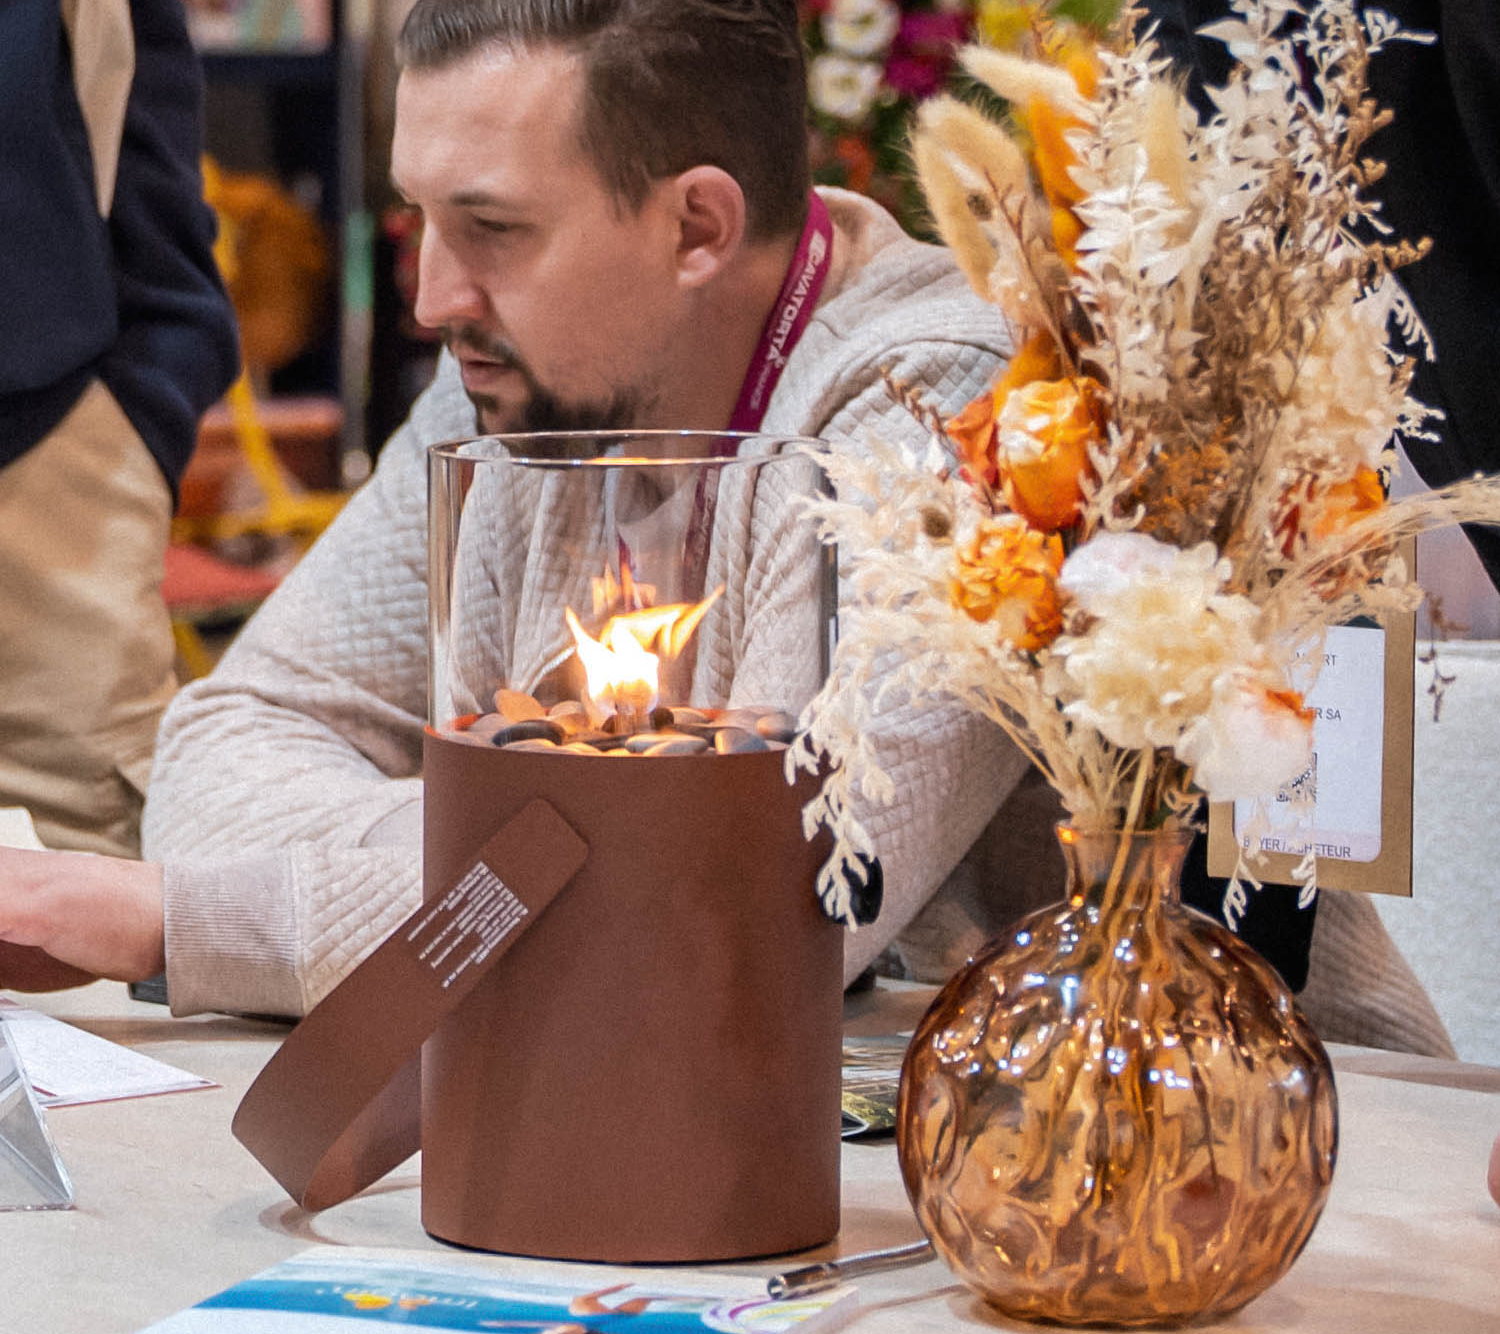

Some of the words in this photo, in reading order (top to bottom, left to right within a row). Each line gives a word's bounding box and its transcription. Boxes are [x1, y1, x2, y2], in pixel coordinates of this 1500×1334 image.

[766, 253, 824, 364] CAVATORTA
[1325, 707, 1342, 721] SA
[1243, 836, 1280, 851] BYER
